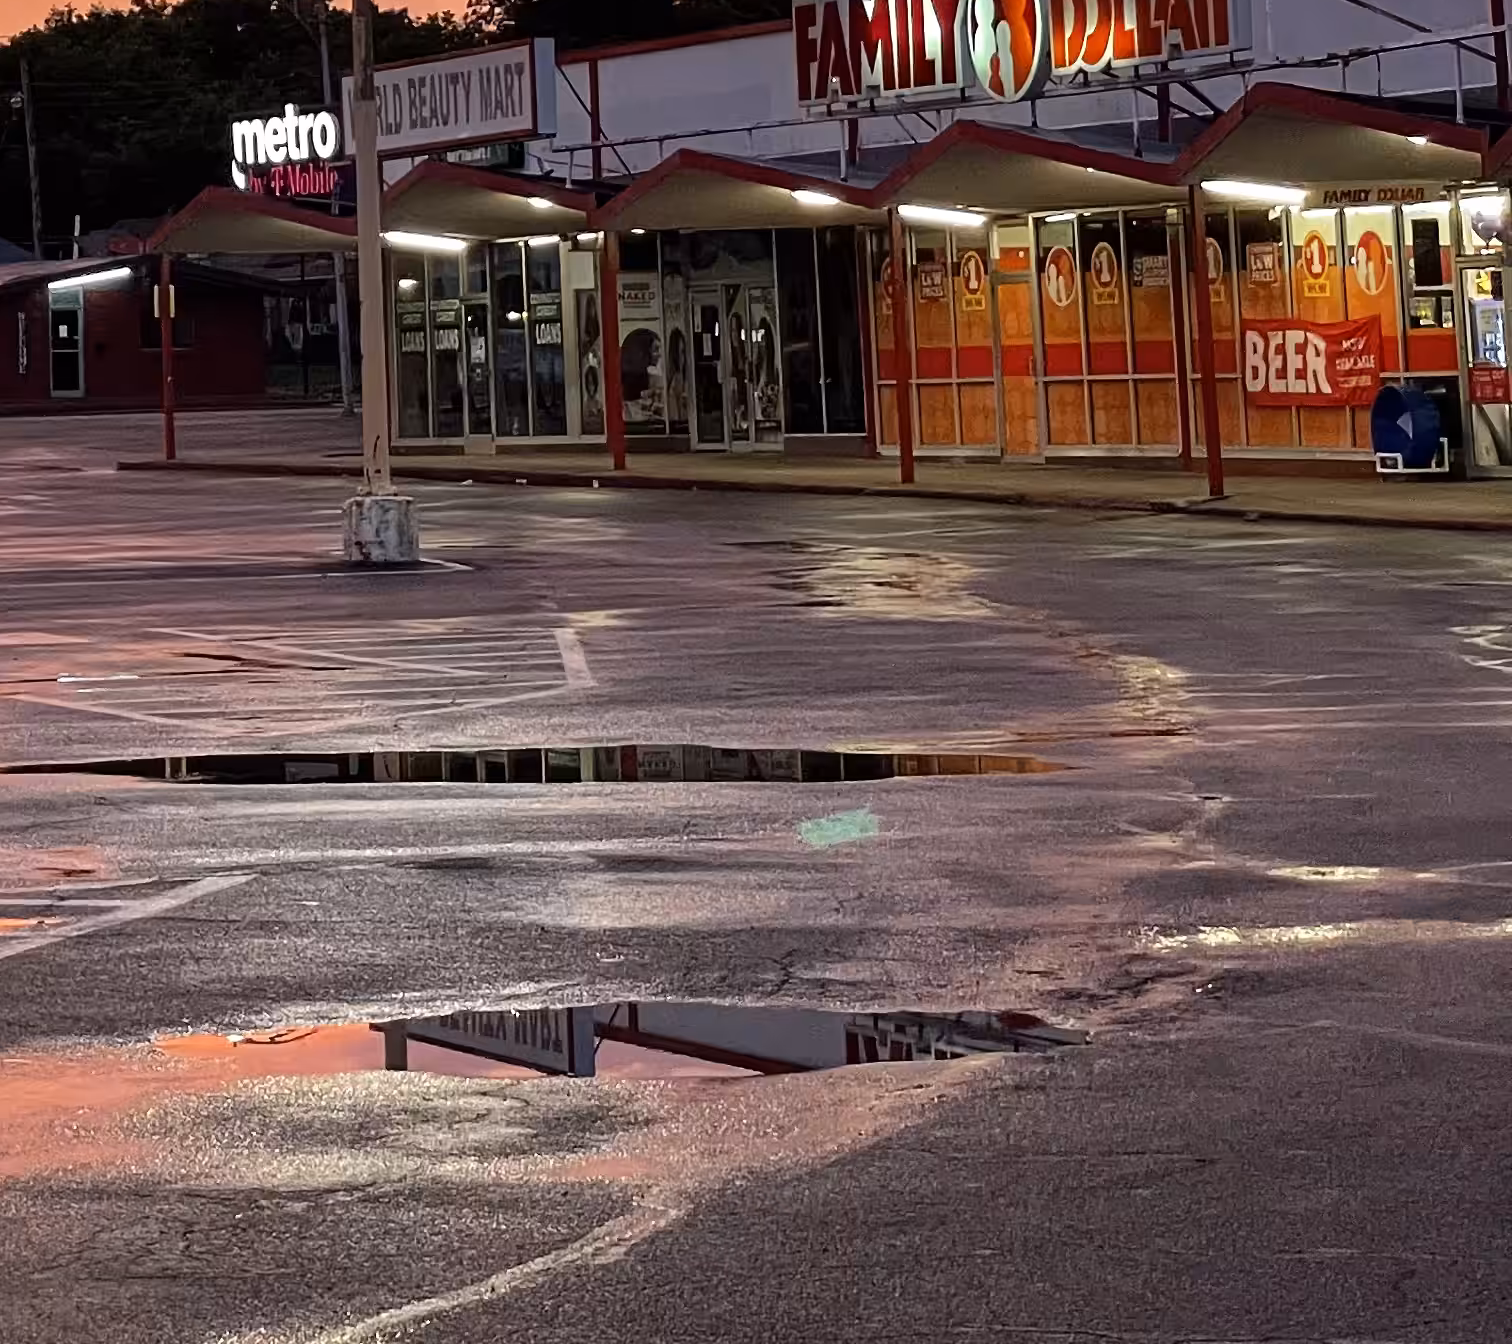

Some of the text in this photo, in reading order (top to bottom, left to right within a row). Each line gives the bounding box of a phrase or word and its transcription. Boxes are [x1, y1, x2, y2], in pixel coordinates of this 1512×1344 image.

[348, 62, 526, 138] RLD BEAUTY MART
[231, 102, 338, 165] metro
[1323, 188, 1372, 205] FAMILY
[617, 290, 656, 301] NAKED
[1244, 329, 1332, 394] BEER
